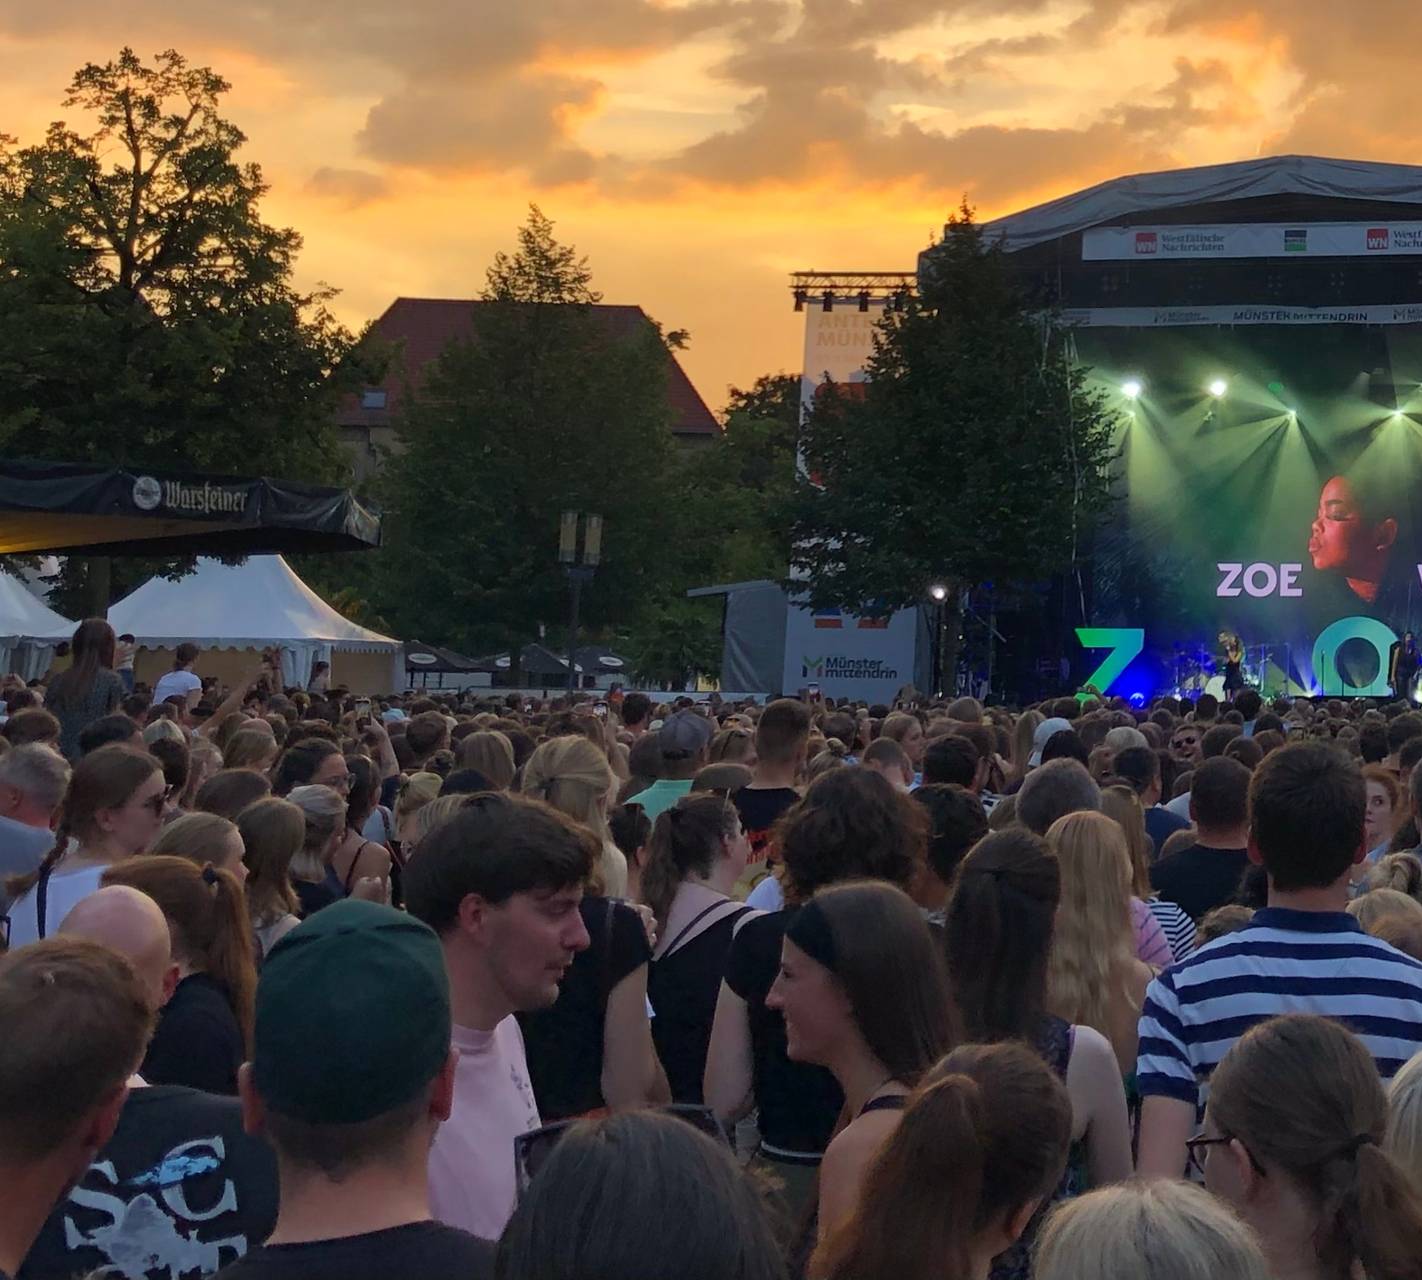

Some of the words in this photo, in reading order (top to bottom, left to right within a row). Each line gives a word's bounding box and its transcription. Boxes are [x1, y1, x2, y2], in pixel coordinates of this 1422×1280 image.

[1162, 242, 1225, 252] Nachrichten
[1368, 237, 1388, 249] WN
[165, 480, 249, 513] Warsteiner
[1216, 563, 1302, 597] ZOE
[825, 656, 883, 669] Münster
[825, 667, 898, 680] mittendrin
